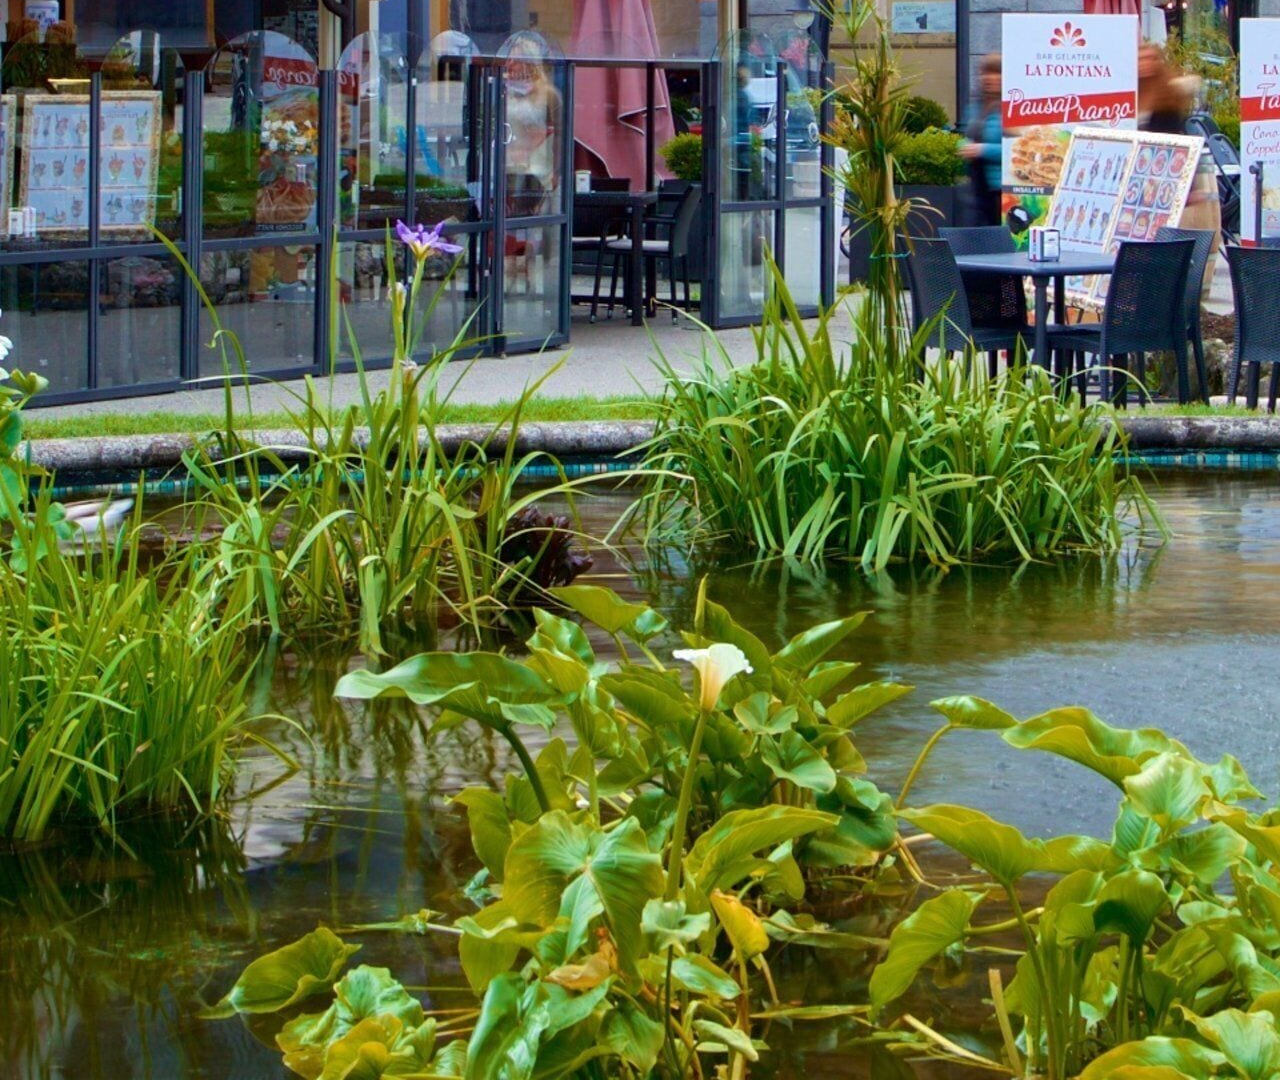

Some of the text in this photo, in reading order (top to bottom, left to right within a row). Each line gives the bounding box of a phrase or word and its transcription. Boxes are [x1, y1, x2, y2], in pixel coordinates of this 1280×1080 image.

[1055, 53, 1100, 61] GELATERIA
[1025, 64, 1111, 77] LA FONTANA
[1263, 64, 1279, 75] LA
[1007, 88, 1135, 127] Pausa Pranzo
[1253, 125, 1279, 140] Cono
